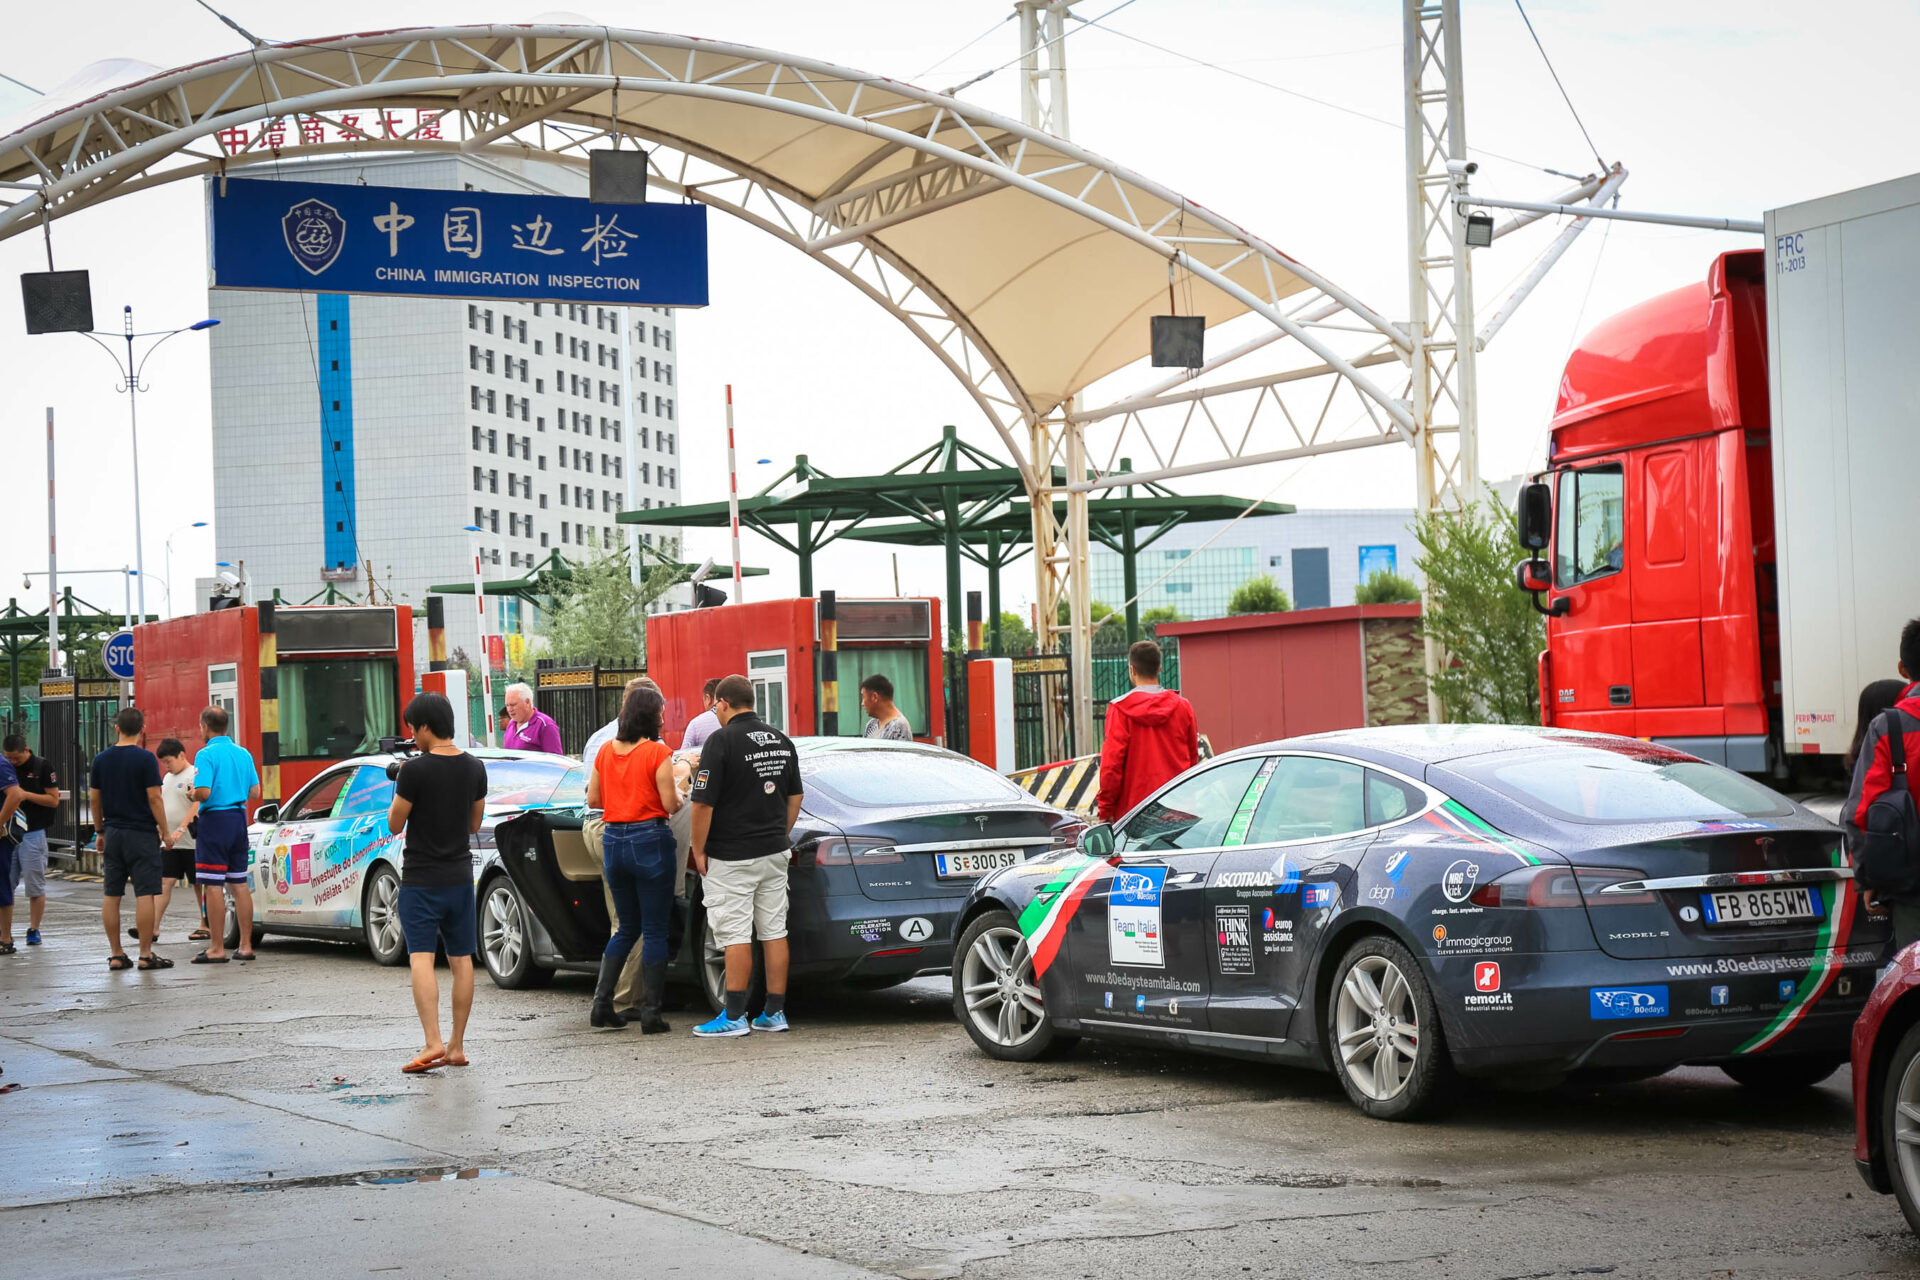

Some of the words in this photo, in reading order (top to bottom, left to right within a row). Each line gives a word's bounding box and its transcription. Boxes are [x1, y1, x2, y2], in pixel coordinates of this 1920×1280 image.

[373, 201, 639, 266] 中国边检
[1777, 233, 1804, 258] FRC
[1777, 256, 1806, 274] 11-2013
[375, 267, 426, 281] CHINA
[434, 269, 539, 286] IMMIGRATION
[548, 274, 640, 290] INSPECTION
[108, 645, 134, 666] STO
[954, 856, 962, 872] S
[972, 854, 997, 870] 300
[1000, 853, 1016, 868] SR
[311, 863, 342, 888] Investujte
[343, 857, 351, 870] do
[1214, 871, 1274, 887] ASCOTRADE
[1449, 872, 1464, 884] NRG
[1236, 890, 1251, 898] Gruppo
[1252, 889, 1273, 898] Ascopiave
[1314, 888, 1330, 902] TIM
[1448, 884, 1462, 896] kick
[1137, 892, 1156, 903] 80edays
[1715, 894, 1743, 920] FB
[1747, 890, 1811, 917] 865WM
[850, 922, 891, 930] ACCELERATING
[850, 927, 891, 935] EVOLUTION
[907, 920, 925, 937] A
[1113, 918, 1135, 933] Team
[1137, 919, 1157, 934] Italia
[1218, 918, 1248, 932] THINK
[1275, 920, 1293, 931] europ
[1226, 932, 1249, 946] PINK
[1263, 930, 1293, 941] assistance
[1446, 935, 1512, 948] immagicgroup
[1609, 932, 1657, 940] MODEL
[1666, 949, 1876, 977] www.80edaysteamitalia.com
[1085, 972, 1200, 993] www.80edaysteamitalia.com
[1464, 992, 1513, 1005] remor.it
[1634, 1006, 1665, 1014] 80edays
